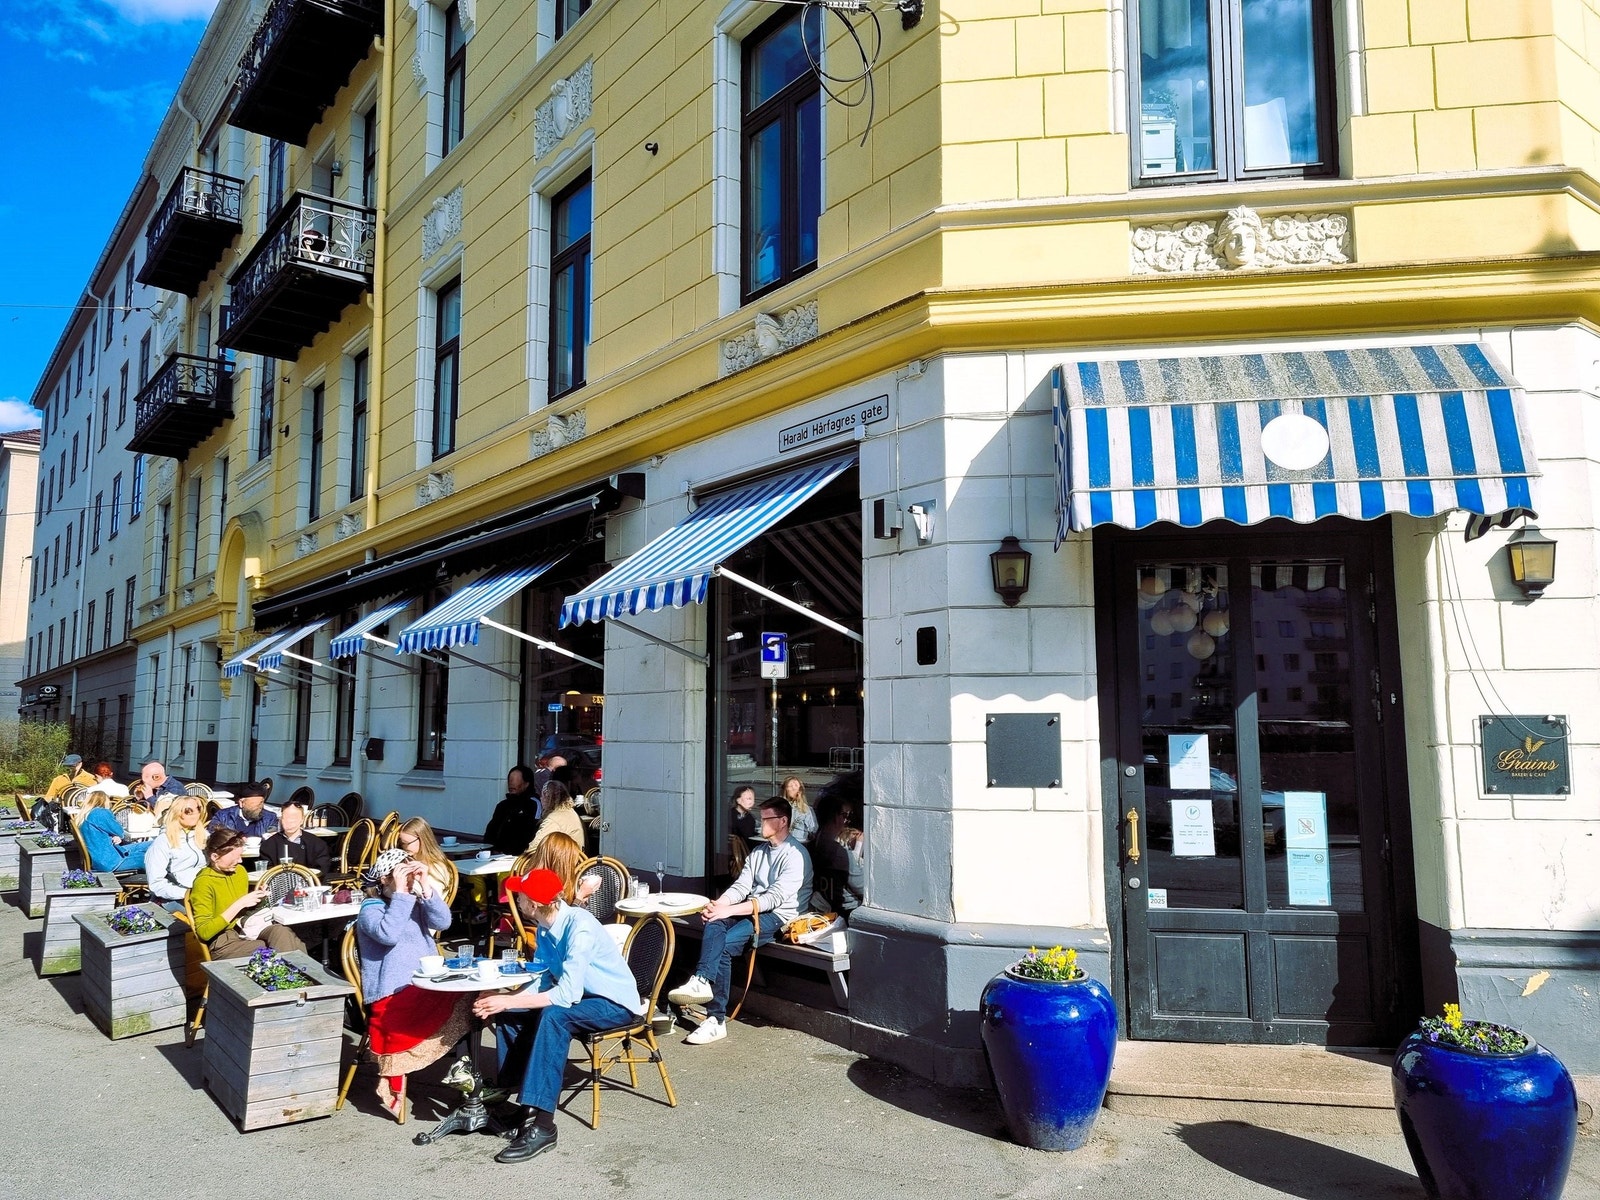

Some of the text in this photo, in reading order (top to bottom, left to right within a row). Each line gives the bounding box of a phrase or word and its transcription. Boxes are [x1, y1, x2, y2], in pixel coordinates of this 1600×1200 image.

[783, 405, 883, 446] Harald Hårfagres gate
[1497, 748, 1559, 771] Grains
